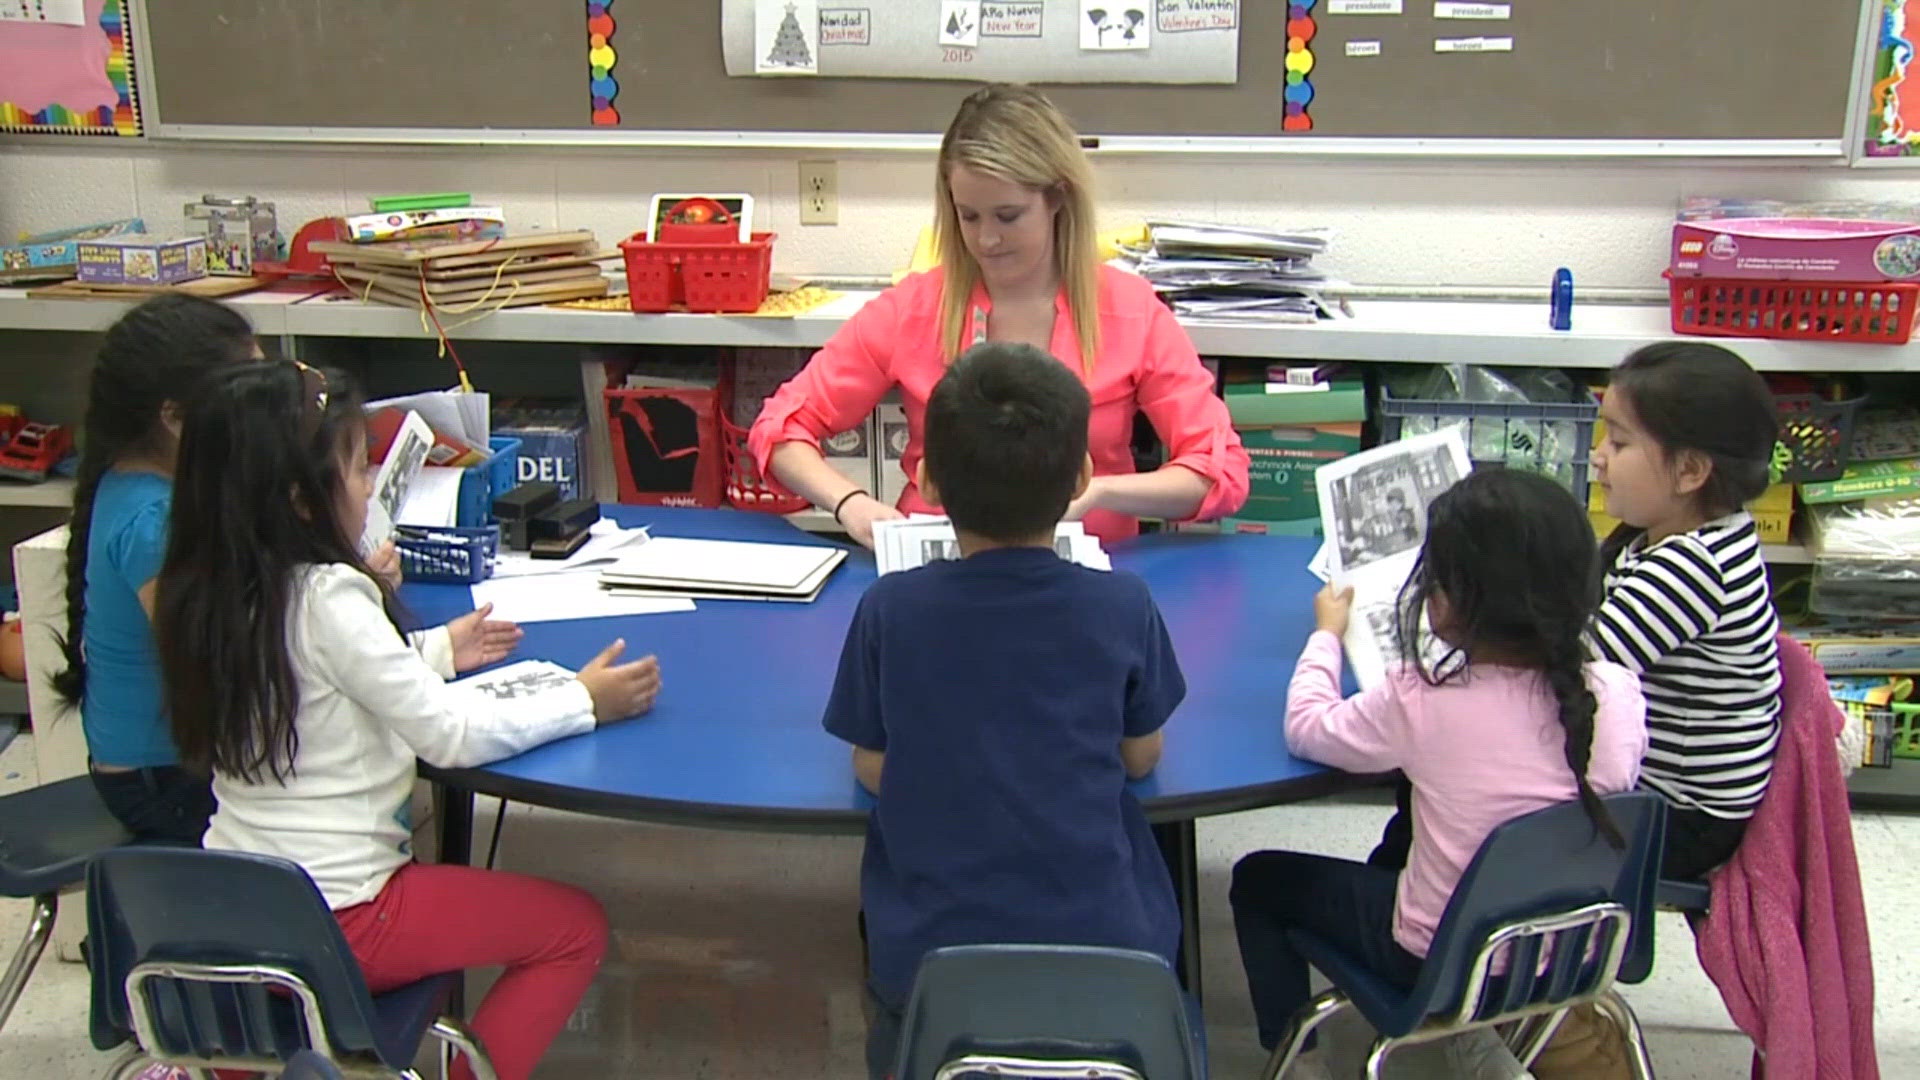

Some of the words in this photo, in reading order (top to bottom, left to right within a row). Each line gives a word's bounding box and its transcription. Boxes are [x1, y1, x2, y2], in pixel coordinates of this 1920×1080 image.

[1007, 6, 1040, 17] Nuevo
[1158, 0, 1179, 12] San
[1345, 1, 1391, 10] presidente
[1452, 7, 1494, 16] president
[987, 21, 1010, 32] New
[1014, 20, 1037, 31] Year
[942, 50, 973, 62] 2015
[517, 456, 570, 481] DEL
[1249, 460, 1292, 469] nchmark
[1833, 479, 1883, 493] Numbers
